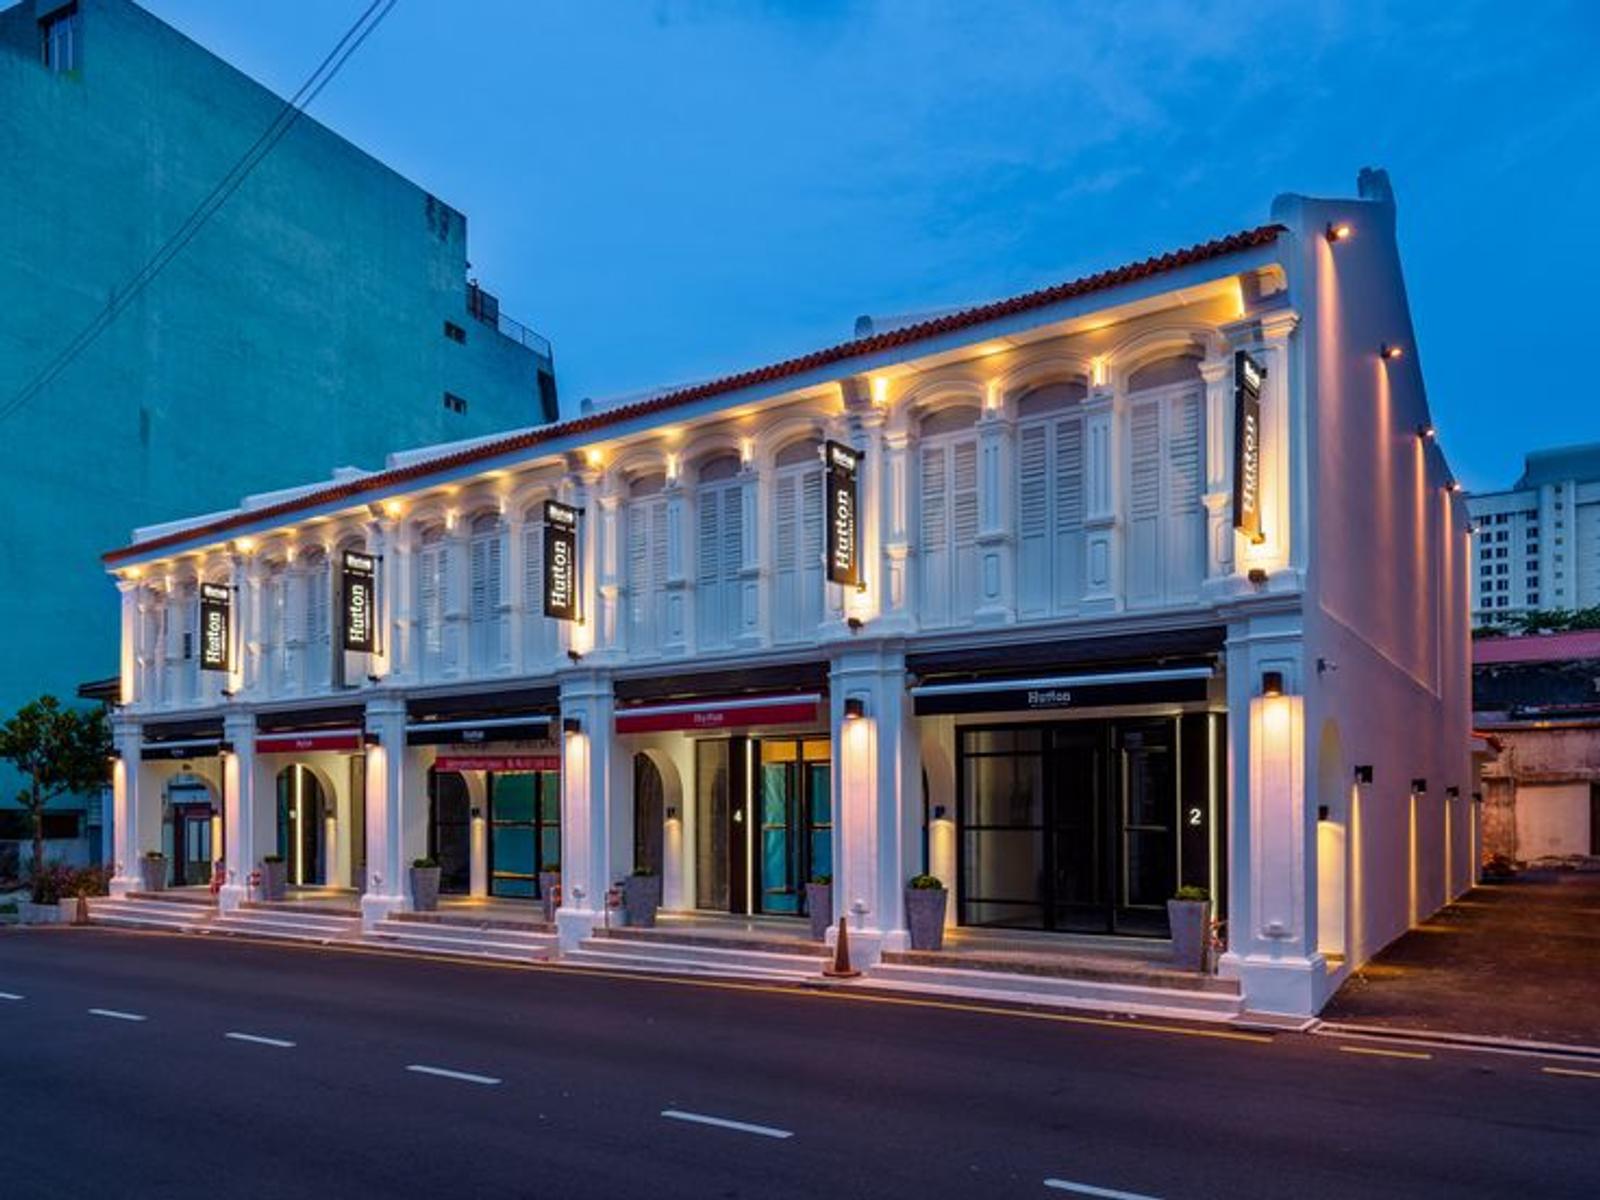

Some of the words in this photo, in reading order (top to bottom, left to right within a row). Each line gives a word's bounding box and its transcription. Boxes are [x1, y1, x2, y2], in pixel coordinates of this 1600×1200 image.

[1243, 414, 1254, 514] Hutton
[836, 490, 849, 569] Hutton
[551, 540, 567, 608] Hutton
[205, 612, 221, 663] Hutton
[349, 584, 365, 642] Hutton
[733, 810, 743, 821] 4
[1190, 808, 1202, 825] 2
